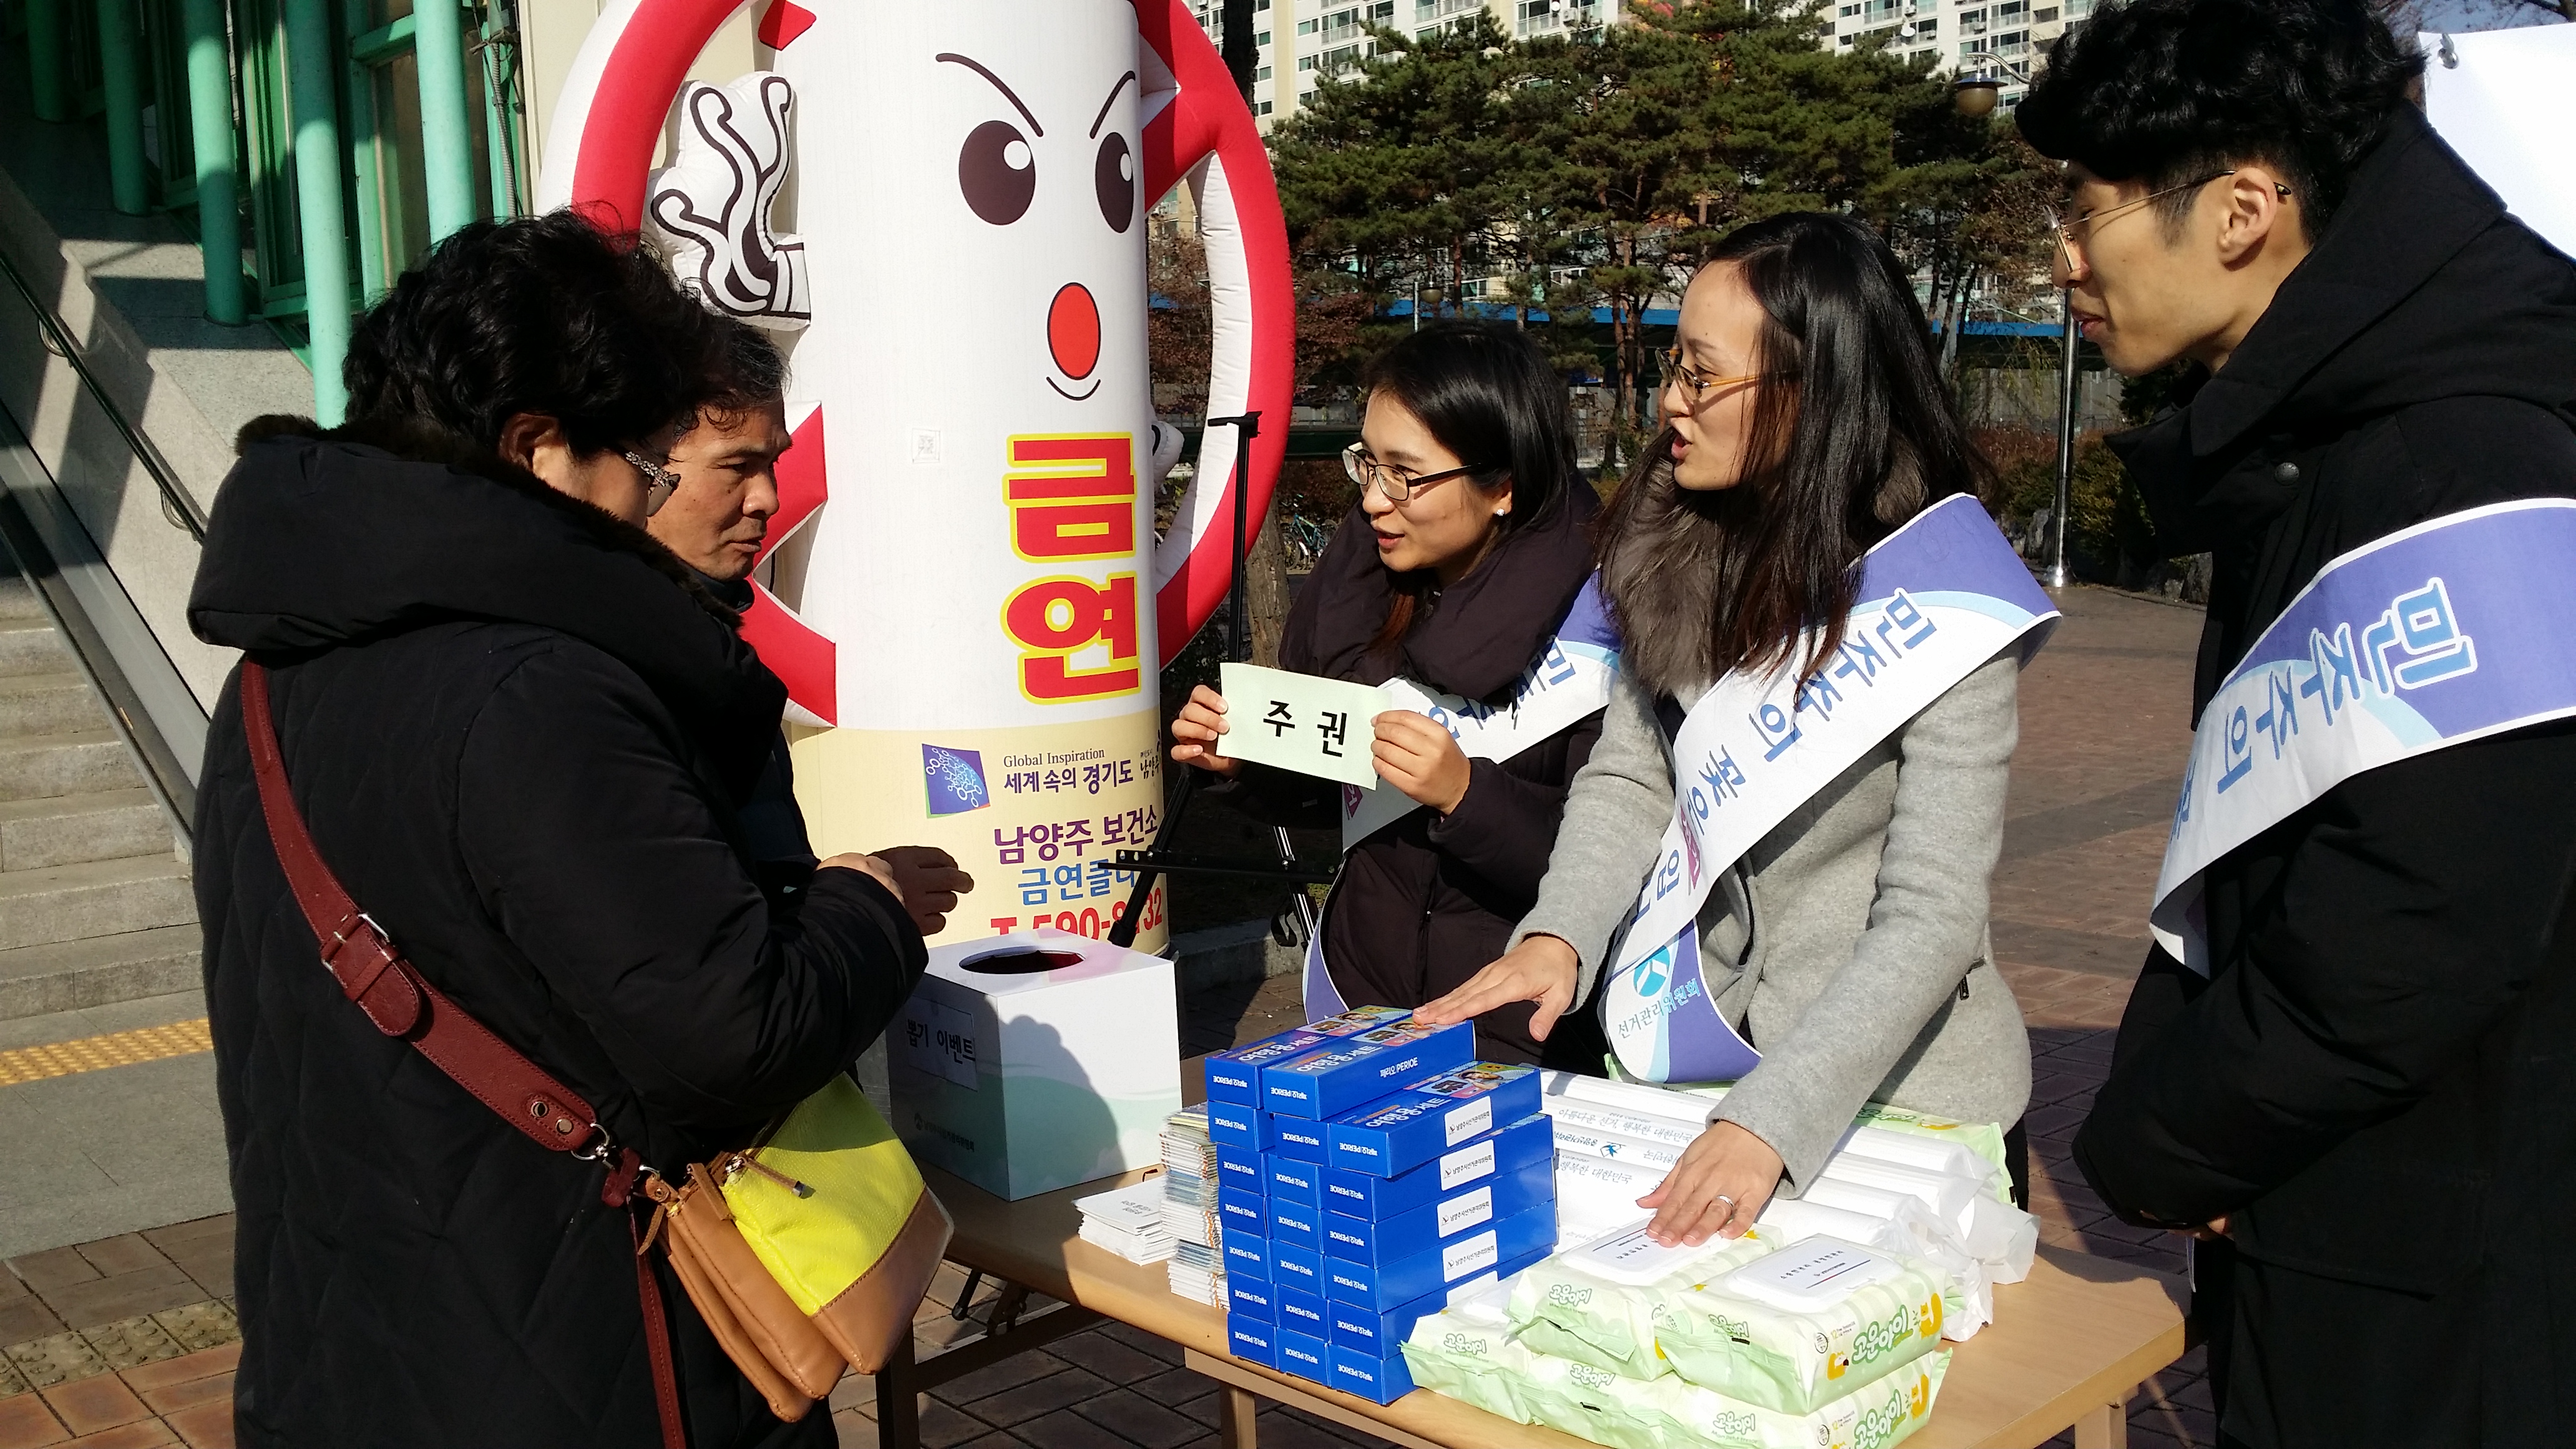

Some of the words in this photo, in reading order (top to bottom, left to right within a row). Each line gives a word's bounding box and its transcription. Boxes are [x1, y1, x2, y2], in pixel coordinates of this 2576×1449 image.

[1001, 432, 1141, 705] 금연
[1749, 588, 1937, 763] 민주주의
[2218, 577, 2477, 795] 민주주의
[1003, 753, 1042, 768] Global
[1047, 748, 1105, 766] Inspiration
[1003, 771, 1040, 794] 세계
[1043, 767, 1076, 793] 속의
[1083, 759, 1134, 794] 경기도
[994, 819, 1093, 865] 남양주
[1101, 804, 1158, 846] 보건소
[1618, 978, 1701, 1038] 선거관리위원회
[907, 1018, 929, 1048] 뽑기
[937, 1029, 976, 1065] 이벤트
[1559, 1109, 1596, 1123] 아름다운
[1622, 1121, 1651, 1136] 행복한
[1654, 1128, 1694, 1143] 대한민국
[1560, 1161, 1589, 1176] 행복한
[1592, 1169, 1633, 1184] 대한민국
[1549, 1284, 1593, 1307] 고운아이
[1443, 1333, 1487, 1355] 고운아이
[1852, 1305, 1910, 1365] 고운아이
[1570, 1364, 1616, 1388] 고운아이
[1713, 1411, 1755, 1435] 고운아이
[1854, 1389, 1903, 1449] 고운아이
